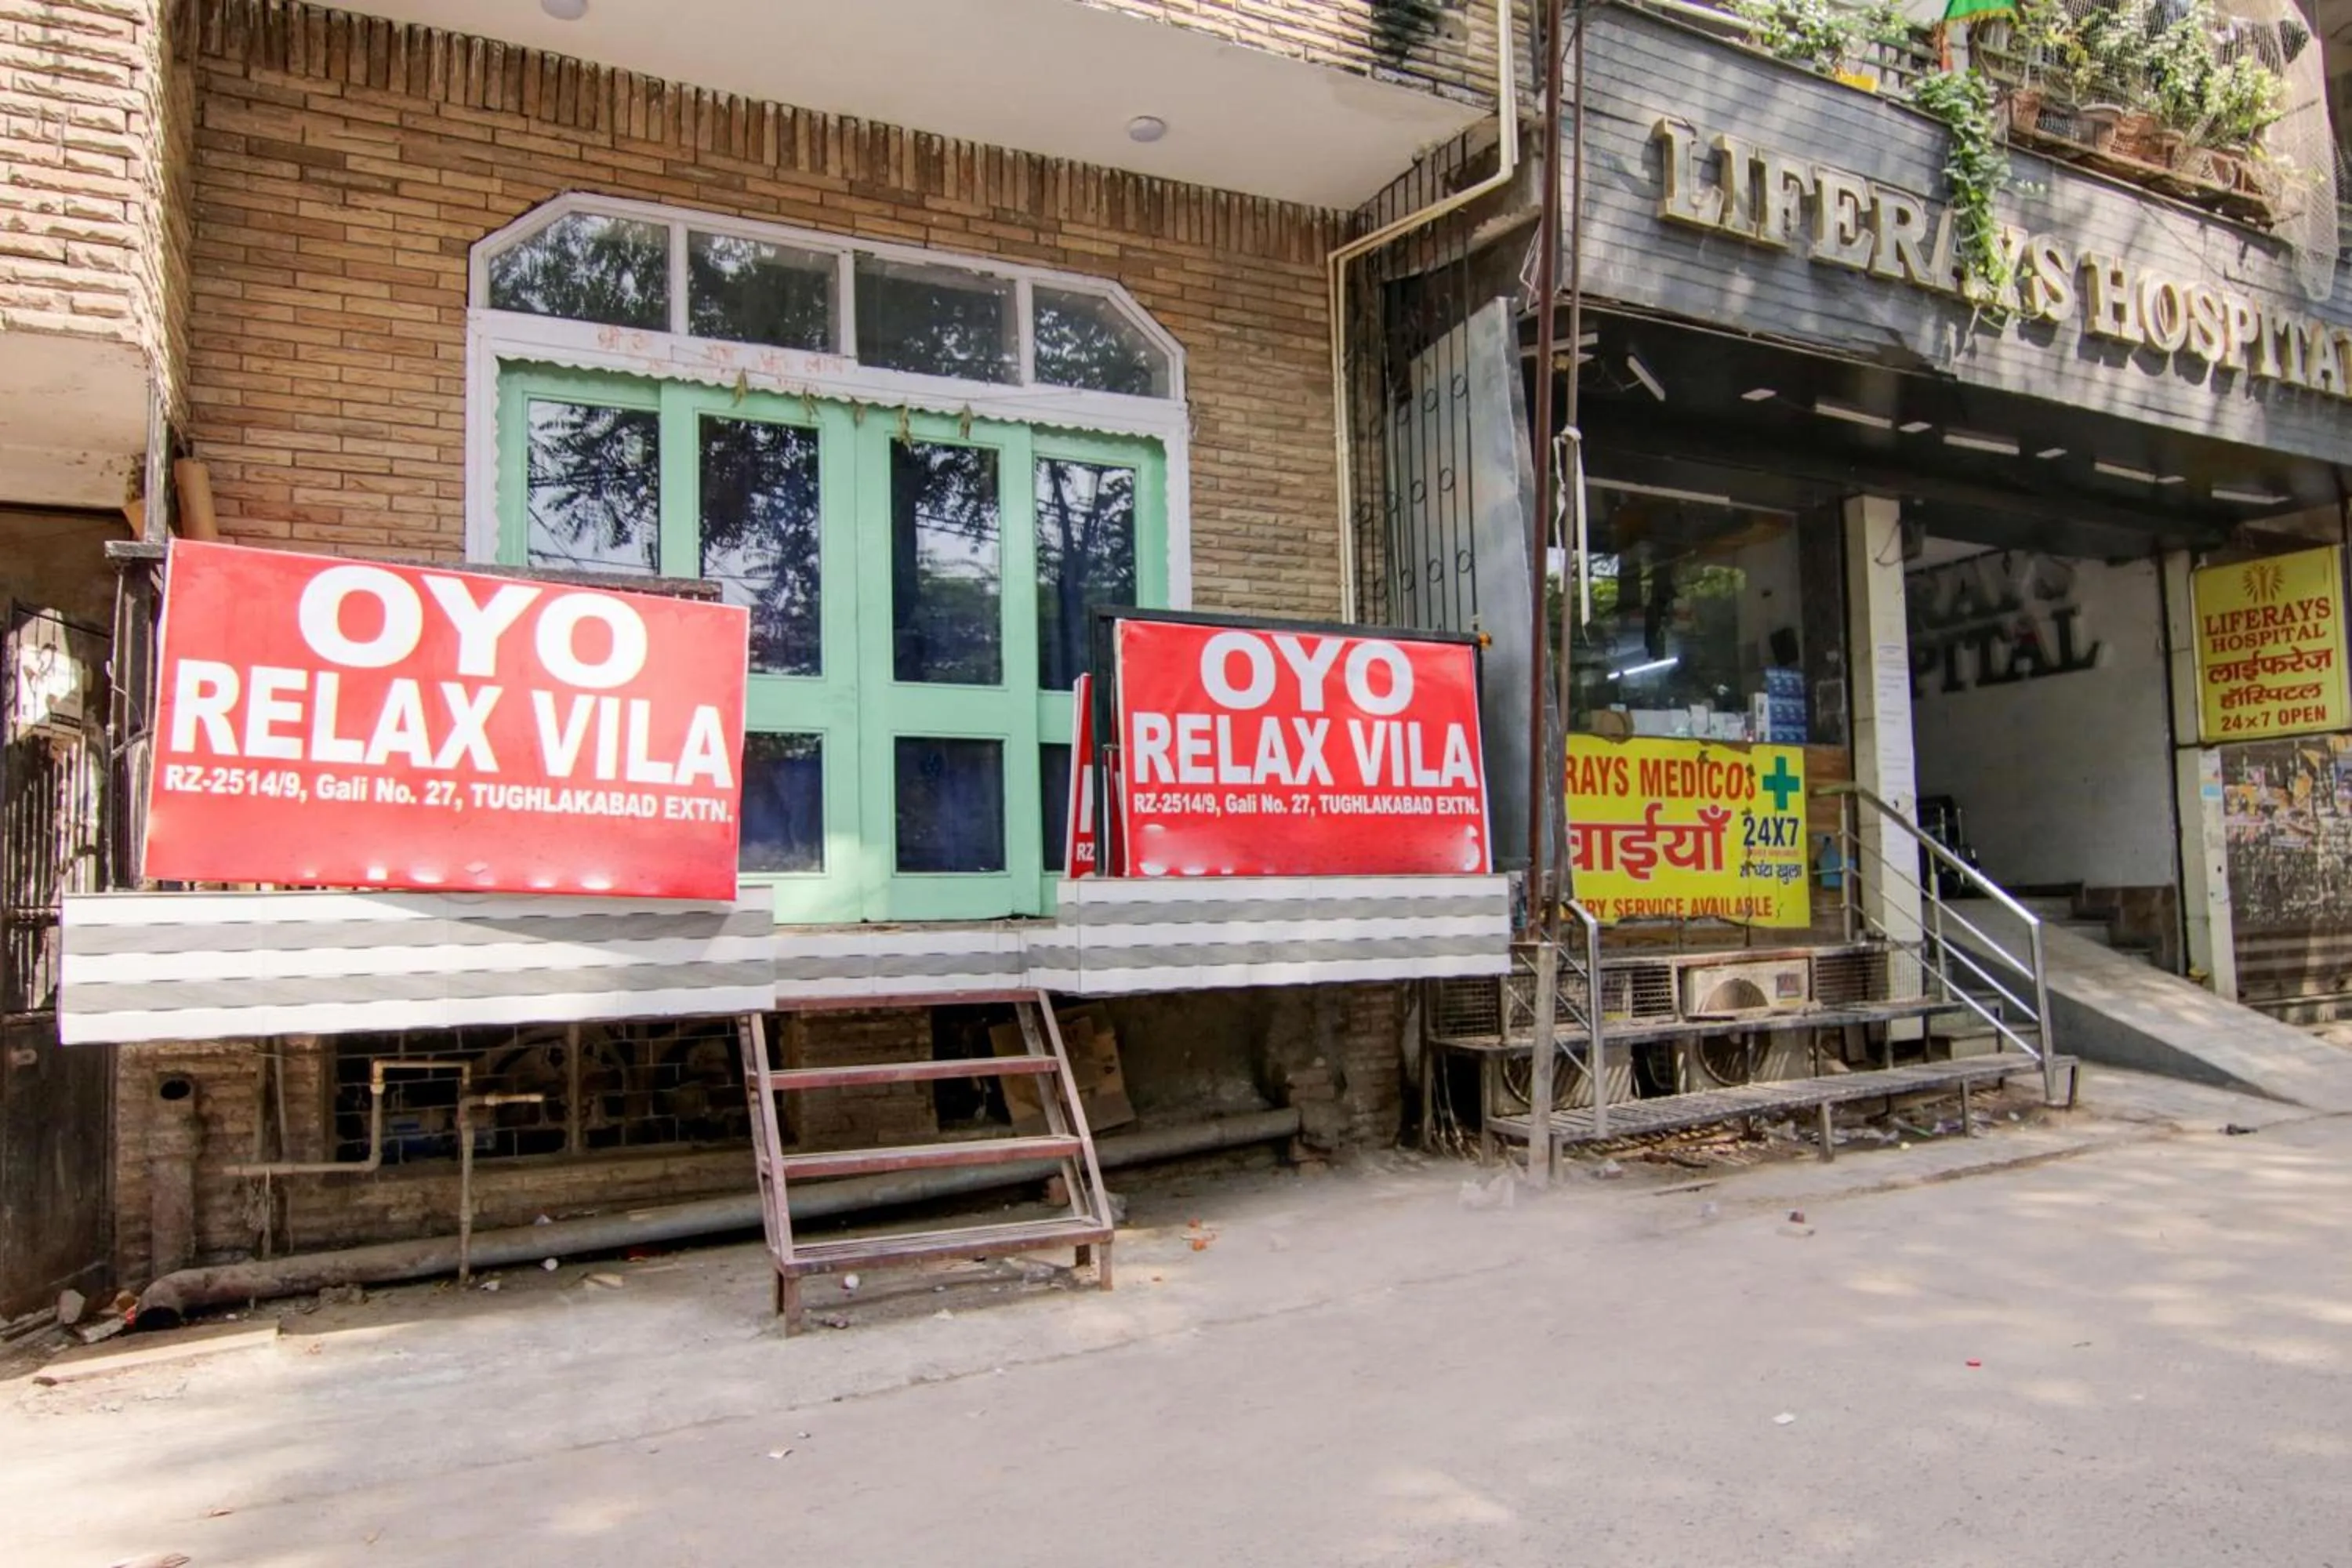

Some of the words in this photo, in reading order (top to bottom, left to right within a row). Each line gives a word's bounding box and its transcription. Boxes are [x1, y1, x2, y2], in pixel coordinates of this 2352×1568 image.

[298, 564, 647, 688] OYO
[2205, 597, 2331, 637] LIFERAYS
[2211, 622, 2326, 653] HOSPITAL
[1200, 631, 1413, 716] OYO
[170, 659, 503, 773] RELAX
[532, 689, 734, 789] VILA
[2278, 705, 2326, 726] OPEN
[1133, 712, 1334, 786] RELAX
[1348, 719, 1478, 789] VILA
[165, 764, 307, 803] RZ-2514/9,
[316, 773, 368, 801] Gali
[376, 777, 416, 804] No.
[424, 780, 463, 811] 27,
[470, 783, 657, 818] TUGHLAKABAD
[664, 795, 733, 822] EXTN.
[1640, 759, 1755, 800] MEDICOS
[1134, 793, 1221, 818] RZ-2514/9,
[1225, 793, 1257, 814] Gali
[1261, 793, 1288, 814] No.
[1291, 793, 1316, 818] 27,
[1319, 794, 1433, 815] TUGHLAKABAD
[1436, 796, 1480, 815] EXTN.
[1744, 816, 1799, 847] 24X7
[1613, 896, 1684, 918] SERVICE
[1690, 896, 1773, 918] AVAILABLE
